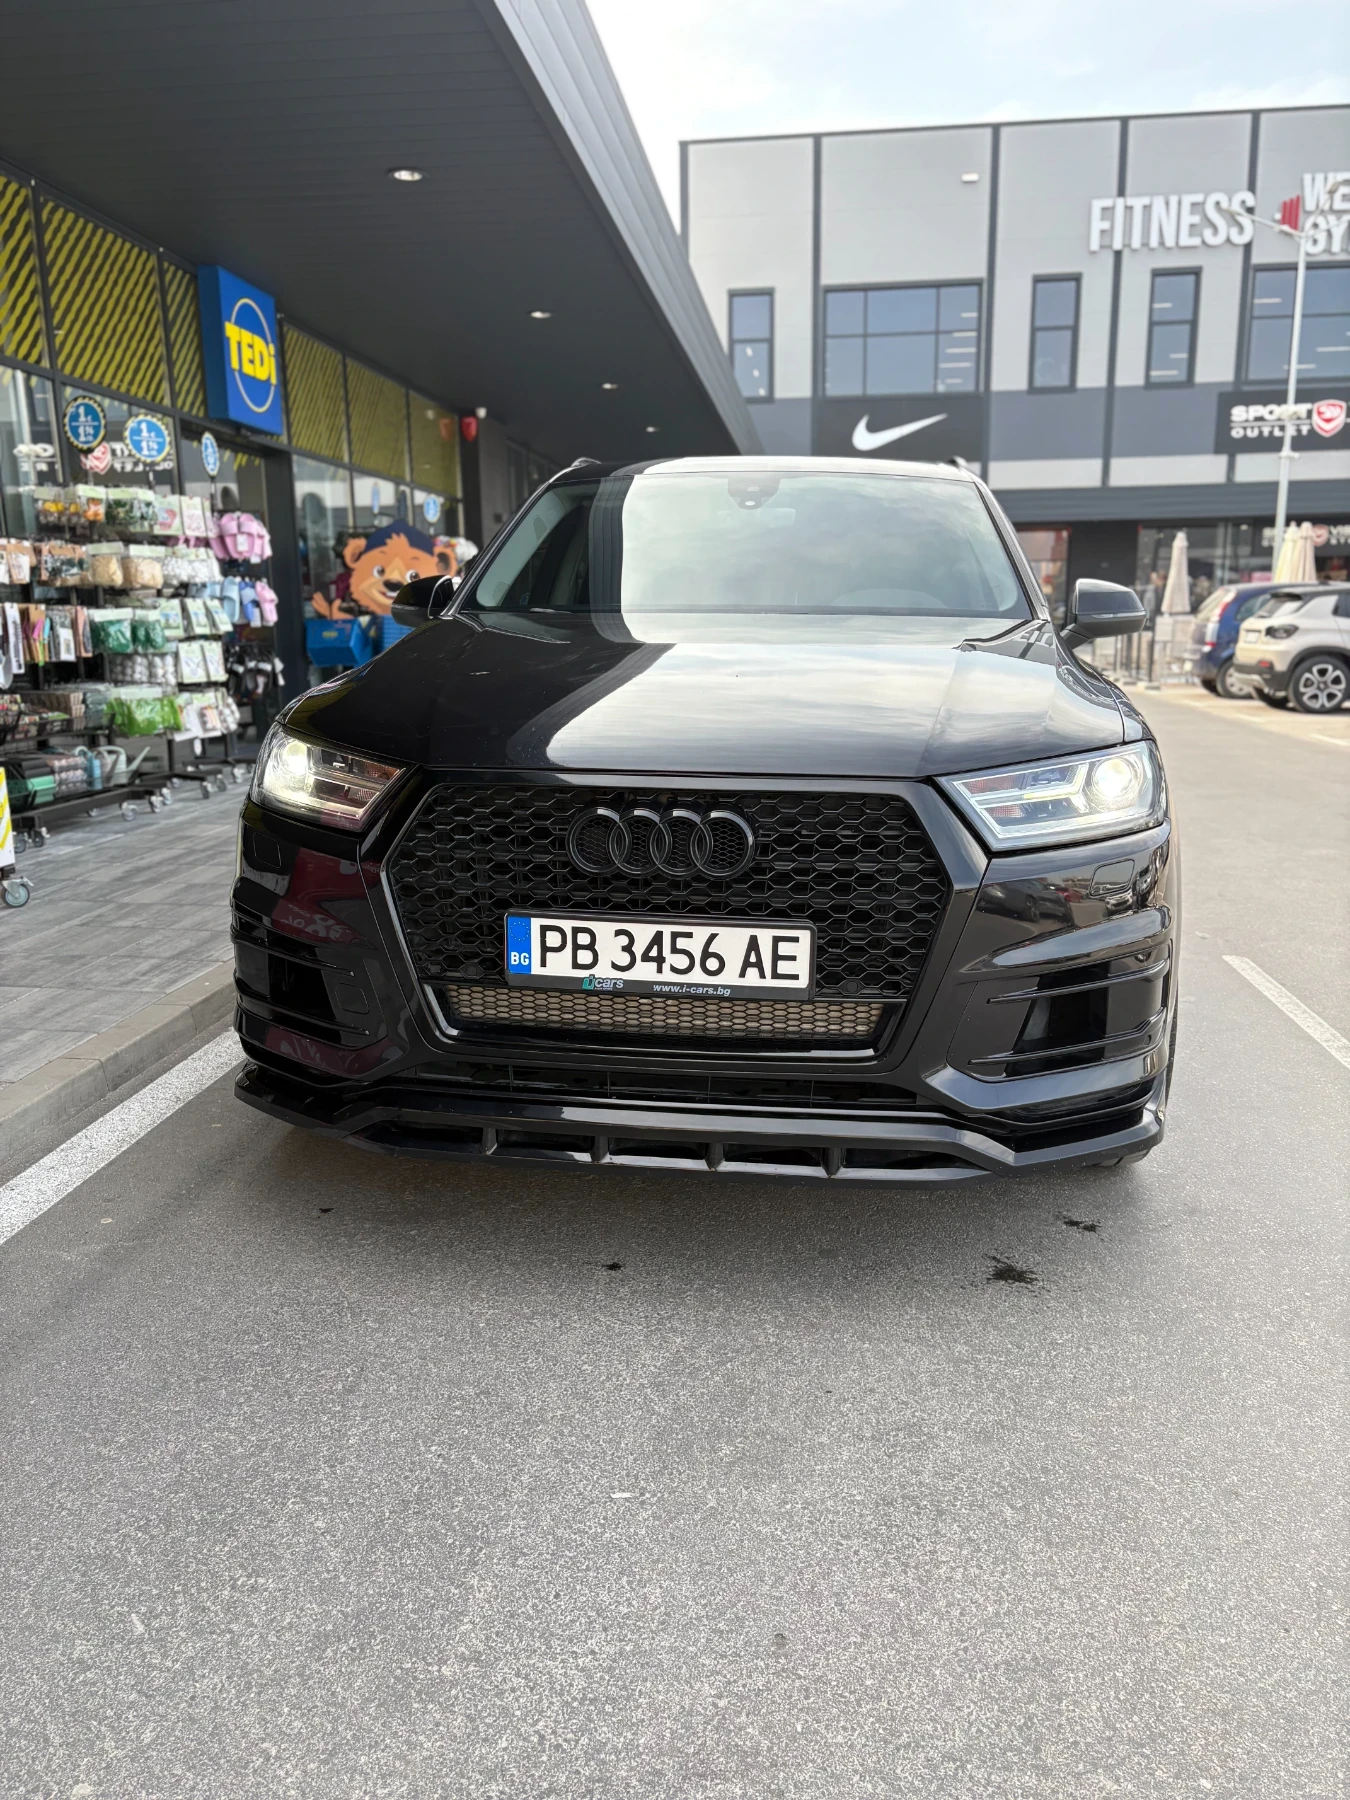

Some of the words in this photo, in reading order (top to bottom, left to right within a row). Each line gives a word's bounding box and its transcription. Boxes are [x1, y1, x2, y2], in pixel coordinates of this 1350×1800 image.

[1089, 190, 1256, 252] FITNESS
[1304, 214, 1350, 255] GY
[1230, 424, 1311, 439] OUTLET
[510, 952, 529, 966] BG
[539, 924, 600, 970] PB
[610, 928, 726, 977] 3456
[738, 934, 800, 980] AE
[653, 984, 731, 996] www.i-cars.bg
